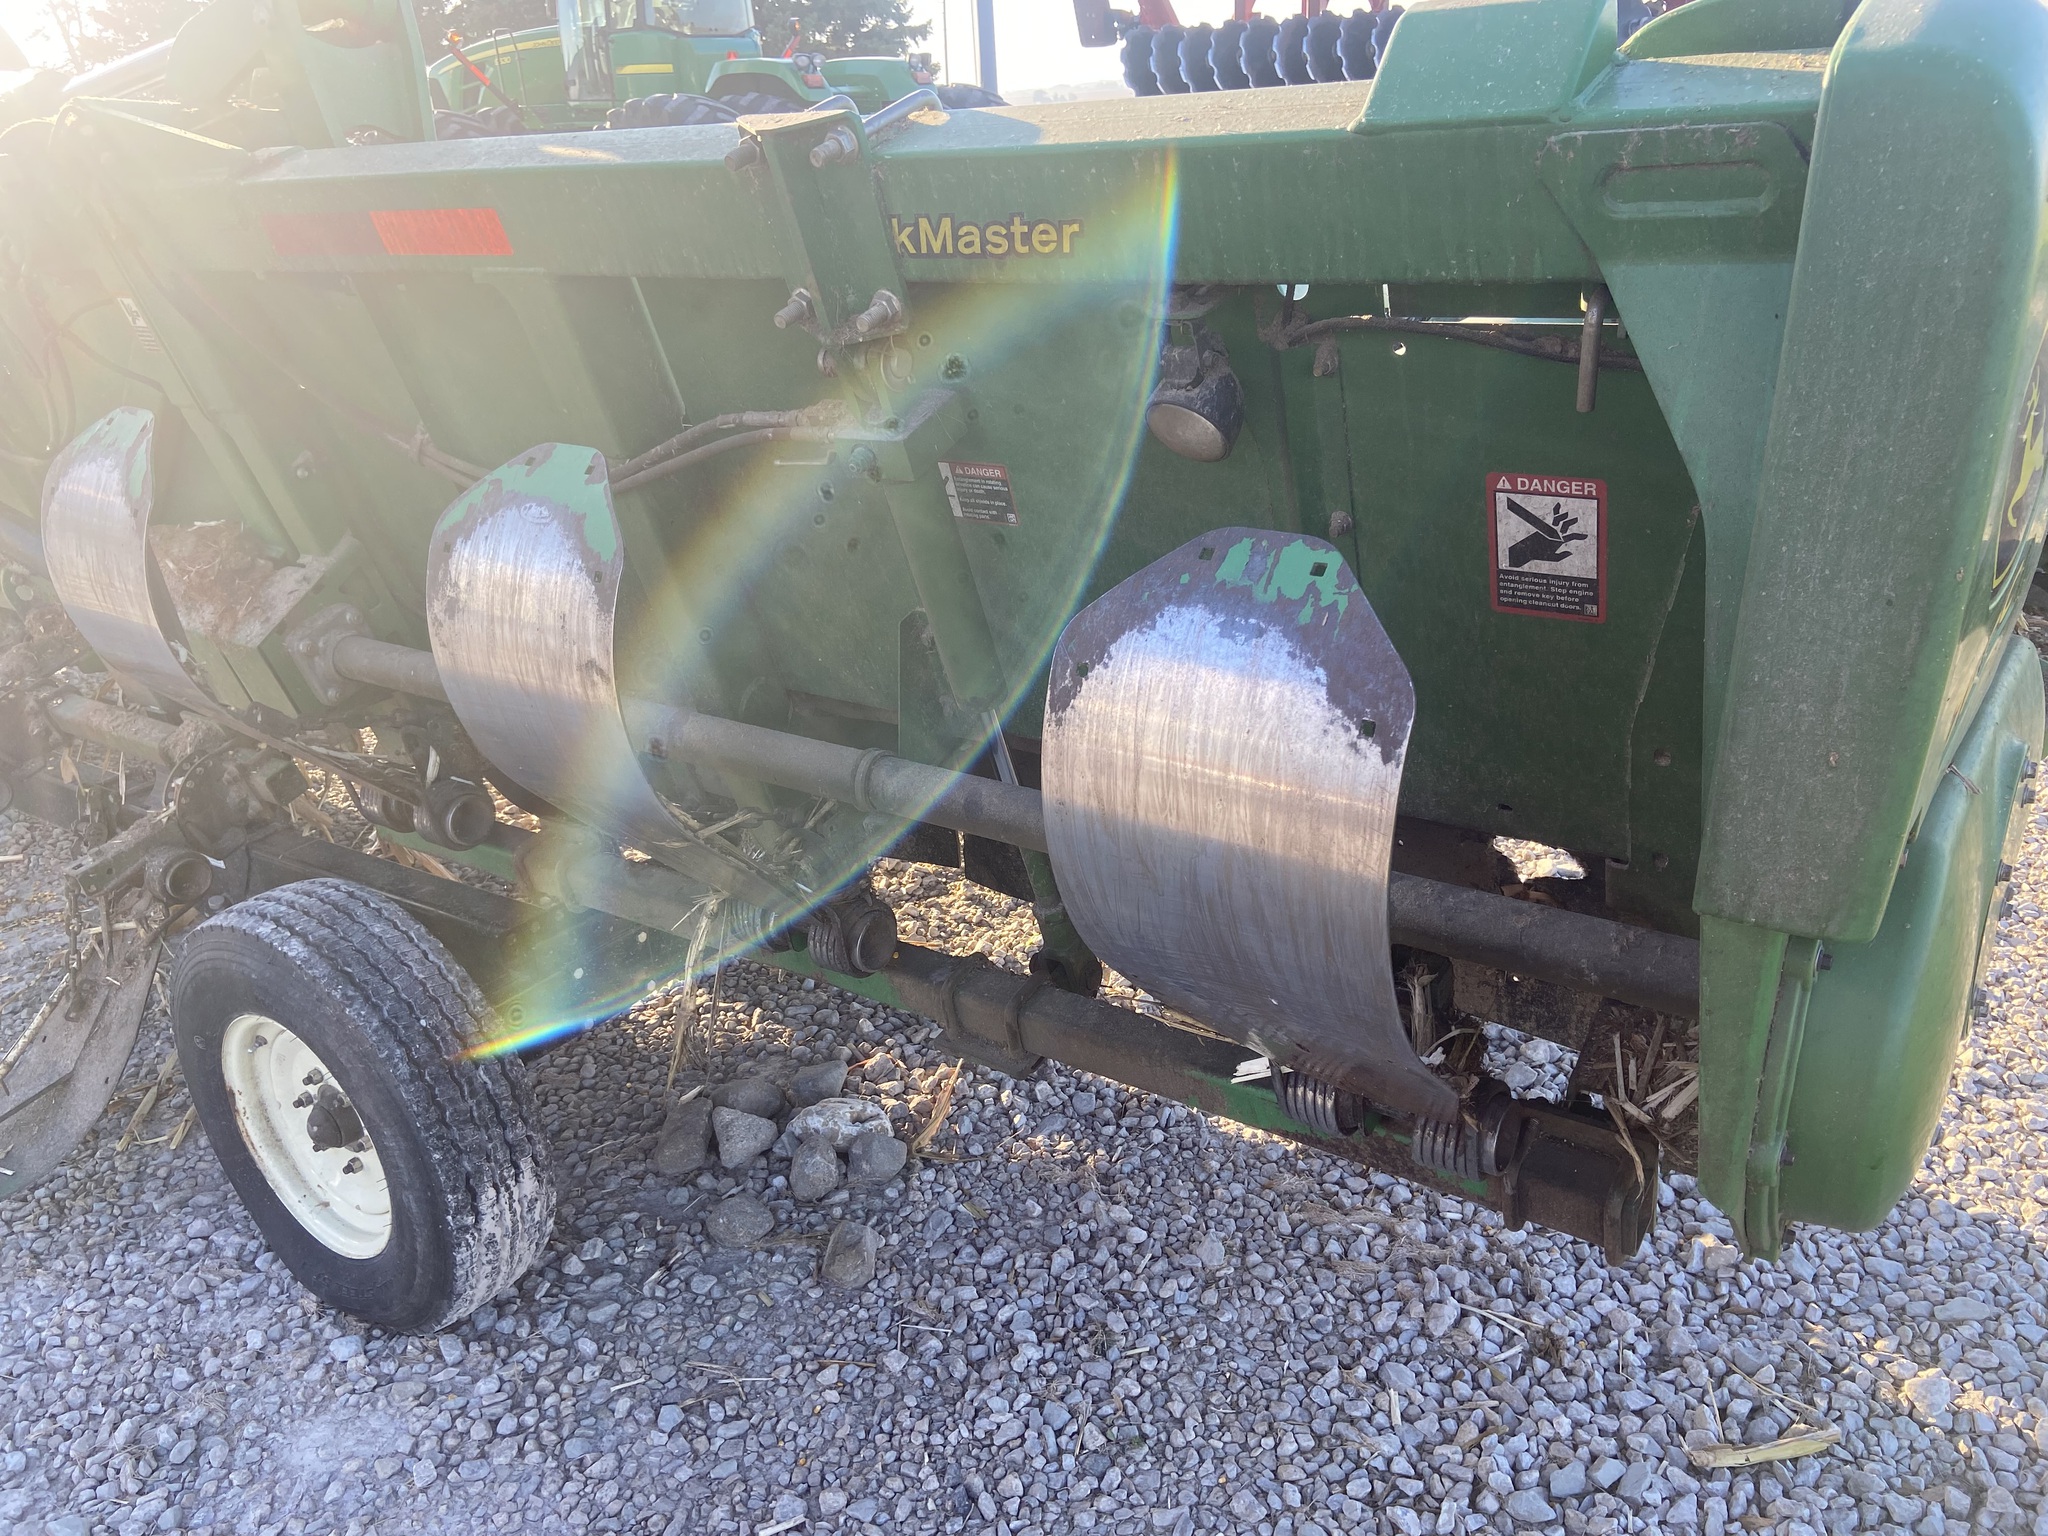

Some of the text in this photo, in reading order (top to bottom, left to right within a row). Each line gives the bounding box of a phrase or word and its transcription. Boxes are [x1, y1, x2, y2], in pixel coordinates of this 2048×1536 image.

[964, 466, 1002, 478] DANGER
[1517, 478, 1596, 496] DANGER
[1499, 573, 1519, 581] Avoid
[1521, 576, 1547, 584] serious
[1549, 578, 1570, 587] injury
[1499, 582, 1548, 591] entanglement.
[1550, 586, 1567, 594] Stop
[1500, 596, 1528, 605] opening
